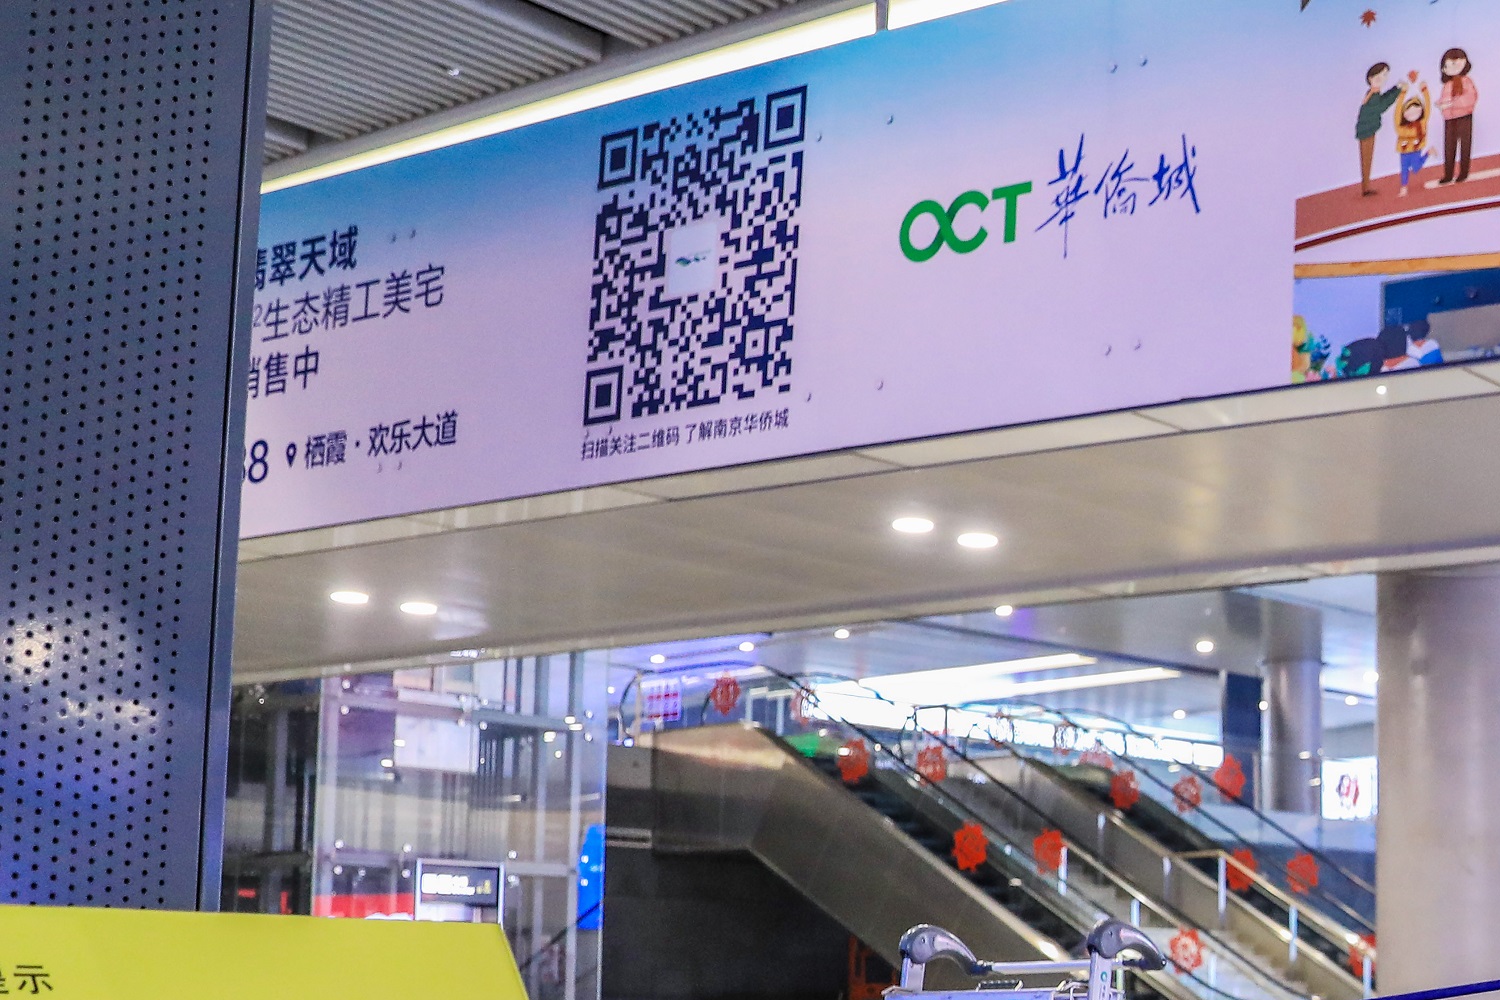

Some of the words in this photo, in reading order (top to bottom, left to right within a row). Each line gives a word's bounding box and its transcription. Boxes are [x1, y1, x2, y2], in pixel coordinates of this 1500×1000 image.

[900, 180, 1033, 262] OCT
[581, 424, 680, 461] 扫描关注二维码
[685, 406, 790, 444] 了解南京华侨城
